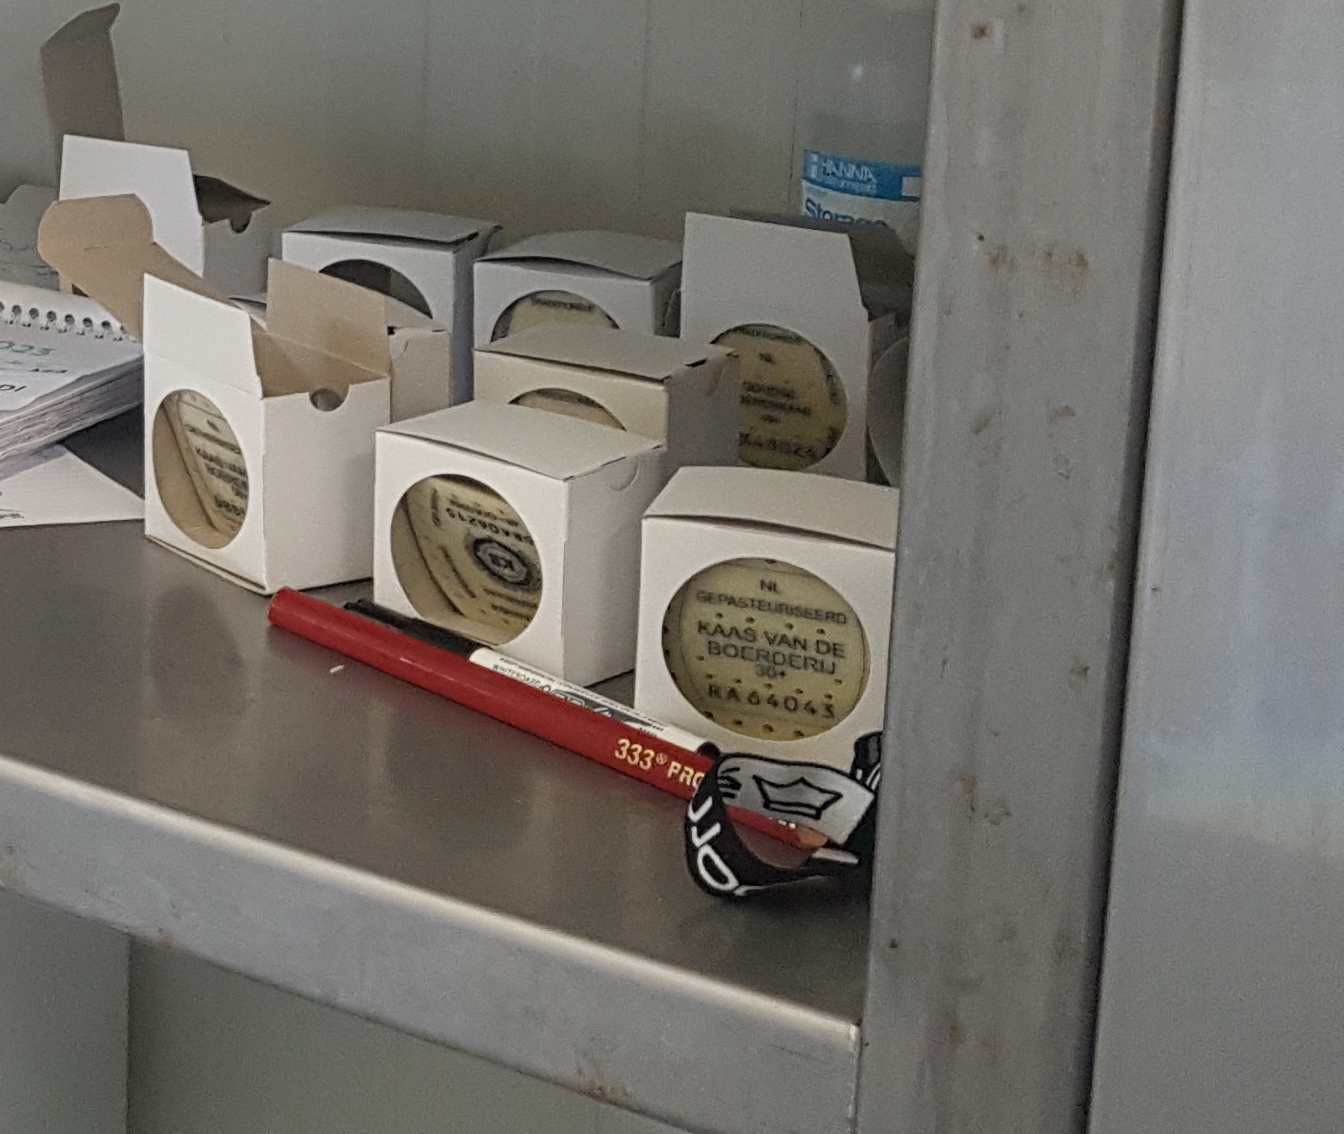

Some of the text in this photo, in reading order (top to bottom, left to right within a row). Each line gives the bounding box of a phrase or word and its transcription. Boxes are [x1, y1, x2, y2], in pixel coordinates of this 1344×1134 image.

[759, 578, 781, 595] NL
[696, 590, 848, 625] GEPASTEURISEERD
[697, 620, 846, 659] KAAS VAN DE
[707, 640, 836, 675] BOERDERIJ
